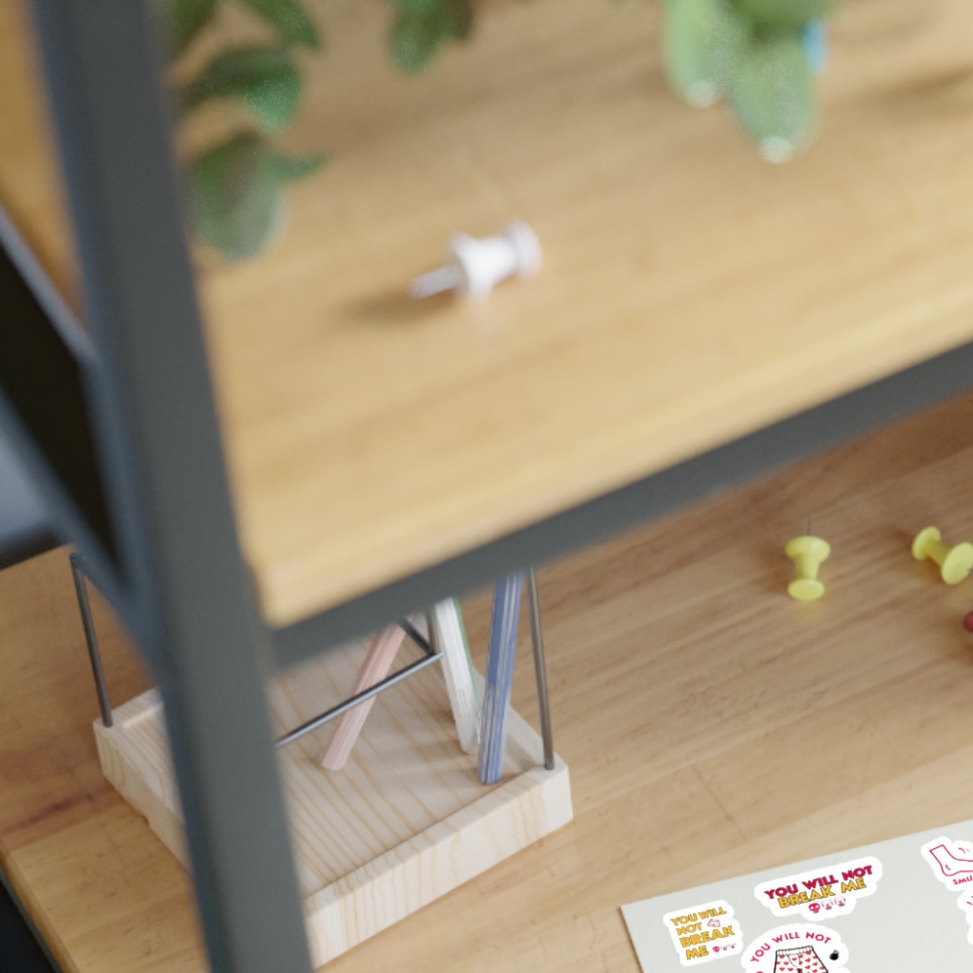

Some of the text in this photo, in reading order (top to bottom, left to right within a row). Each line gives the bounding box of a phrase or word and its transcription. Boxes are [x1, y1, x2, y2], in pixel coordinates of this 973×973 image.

[764, 864, 872, 899] YOU WILL NOT
[777, 877, 867, 909] BREAK ME
[670, 906, 727, 926] YOU WILL
[675, 922, 702, 936] NOT
[679, 925, 736, 948] BREAK
[686, 945, 709, 960] ME
[750, 931, 832, 962] YOU WILL NOT
